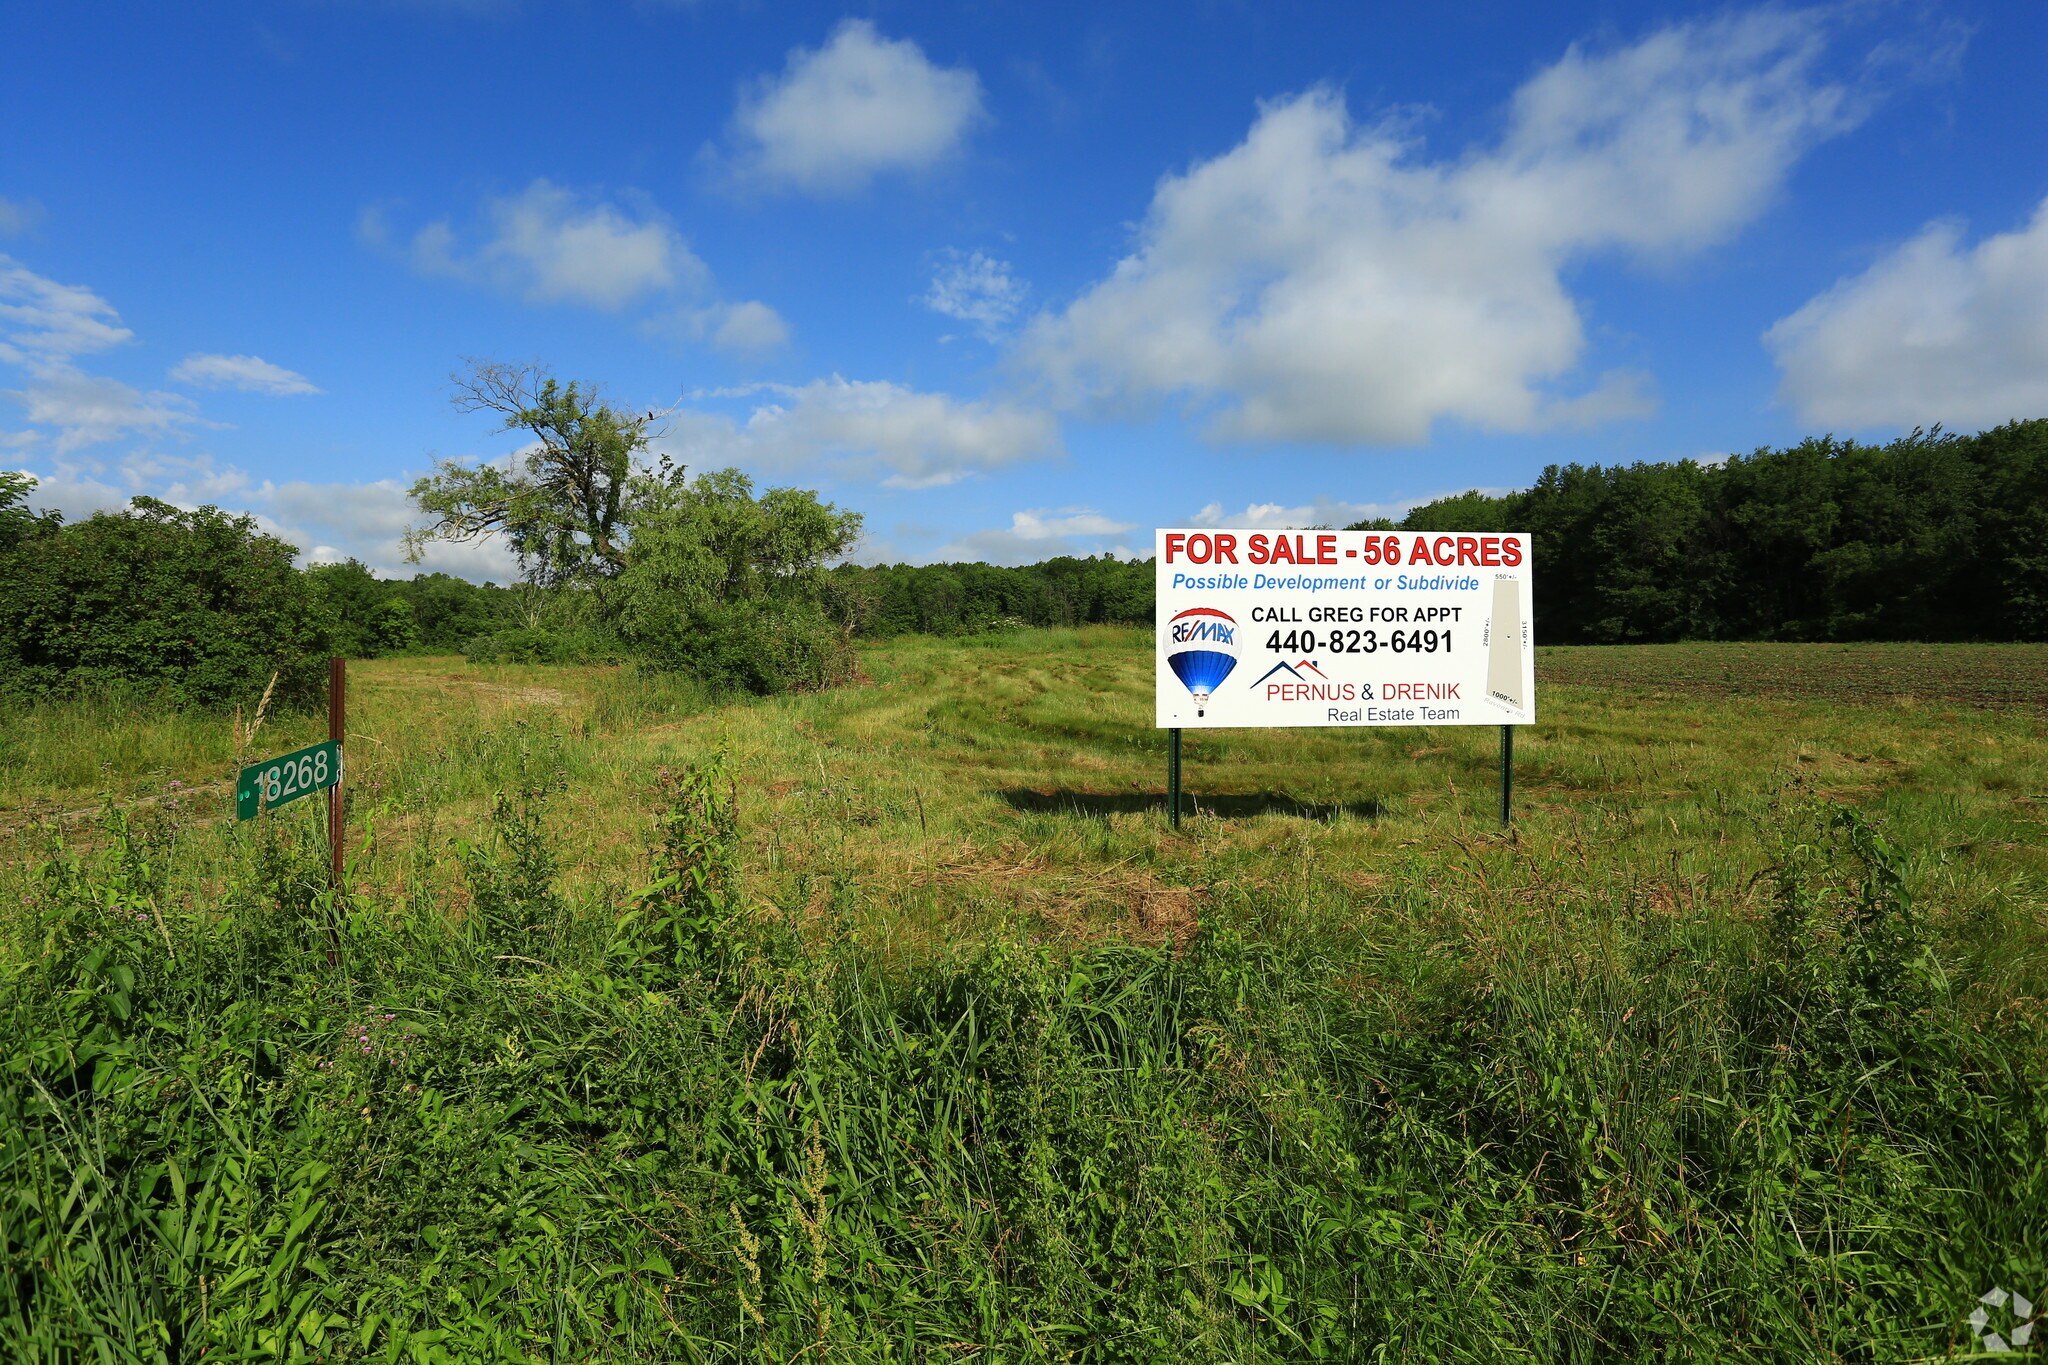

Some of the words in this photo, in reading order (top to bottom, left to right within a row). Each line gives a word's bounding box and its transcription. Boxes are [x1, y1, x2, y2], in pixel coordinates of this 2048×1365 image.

[1166, 533, 1238, 564] FOR
[1248, 534, 1337, 564] SALE
[1346, 549, 1357, 558] -
[1364, 536, 1401, 565] 56
[1409, 537, 1522, 566] ACRES
[1173, 573, 1248, 589] Possible
[1253, 575, 1366, 592] Development
[1375, 578, 1392, 589] or
[1397, 575, 1479, 590] Subdivide
[1252, 607, 1302, 622] CALL
[1309, 608, 1363, 622] GREG
[1370, 608, 1408, 622] FOR
[1414, 608, 1462, 622] APPT
[1172, 620, 1235, 645] RE/MAX
[1266, 629, 1452, 653] 440-823-6491
[1267, 684, 1355, 701] PERNUS
[1362, 684, 1374, 700] &
[1383, 683, 1460, 700] DRENIK
[1328, 708, 1362, 722] Real
[1368, 708, 1414, 721] Estate
[1420, 707, 1459, 720] Team
[254, 750, 328, 801] 18268
